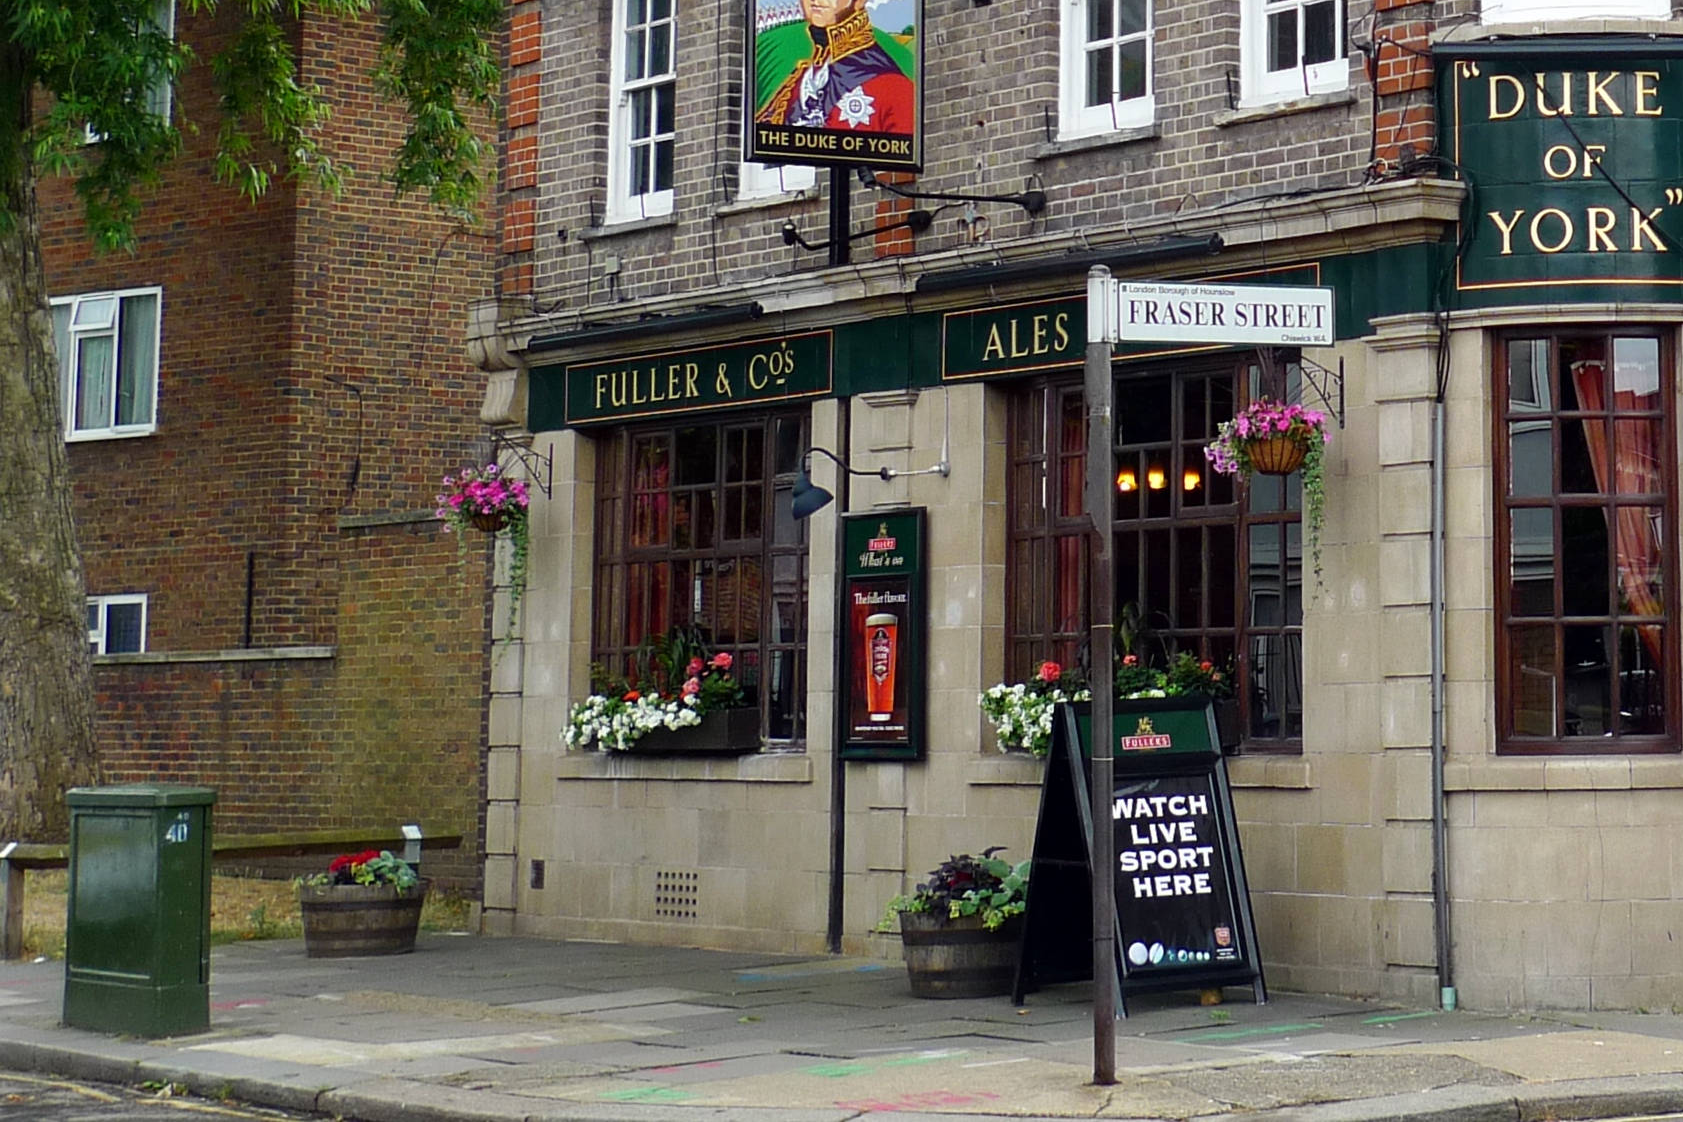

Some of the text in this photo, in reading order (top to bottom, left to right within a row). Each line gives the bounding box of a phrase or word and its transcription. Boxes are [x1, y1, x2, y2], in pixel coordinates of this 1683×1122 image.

[759, 130, 910, 155] THE DUKE OF YORK
[1543, 145, 1606, 179] OF
[1128, 285, 1236, 296] London Borough of Hounslow
[1128, 299, 1327, 329] FRASER STREET
[982, 313, 1069, 361] ALES
[1280, 333, 1311, 342] Chiswick
[595, 362, 700, 409] FULLER
[715, 362, 732, 398] &
[859, 551, 904, 568] What's on
[854, 592, 868, 604] The
[1112, 795, 1208, 819] WATCH
[1130, 821, 1197, 845] LIVE
[1120, 846, 1213, 872] SPORT
[1133, 873, 1212, 898] HERE
